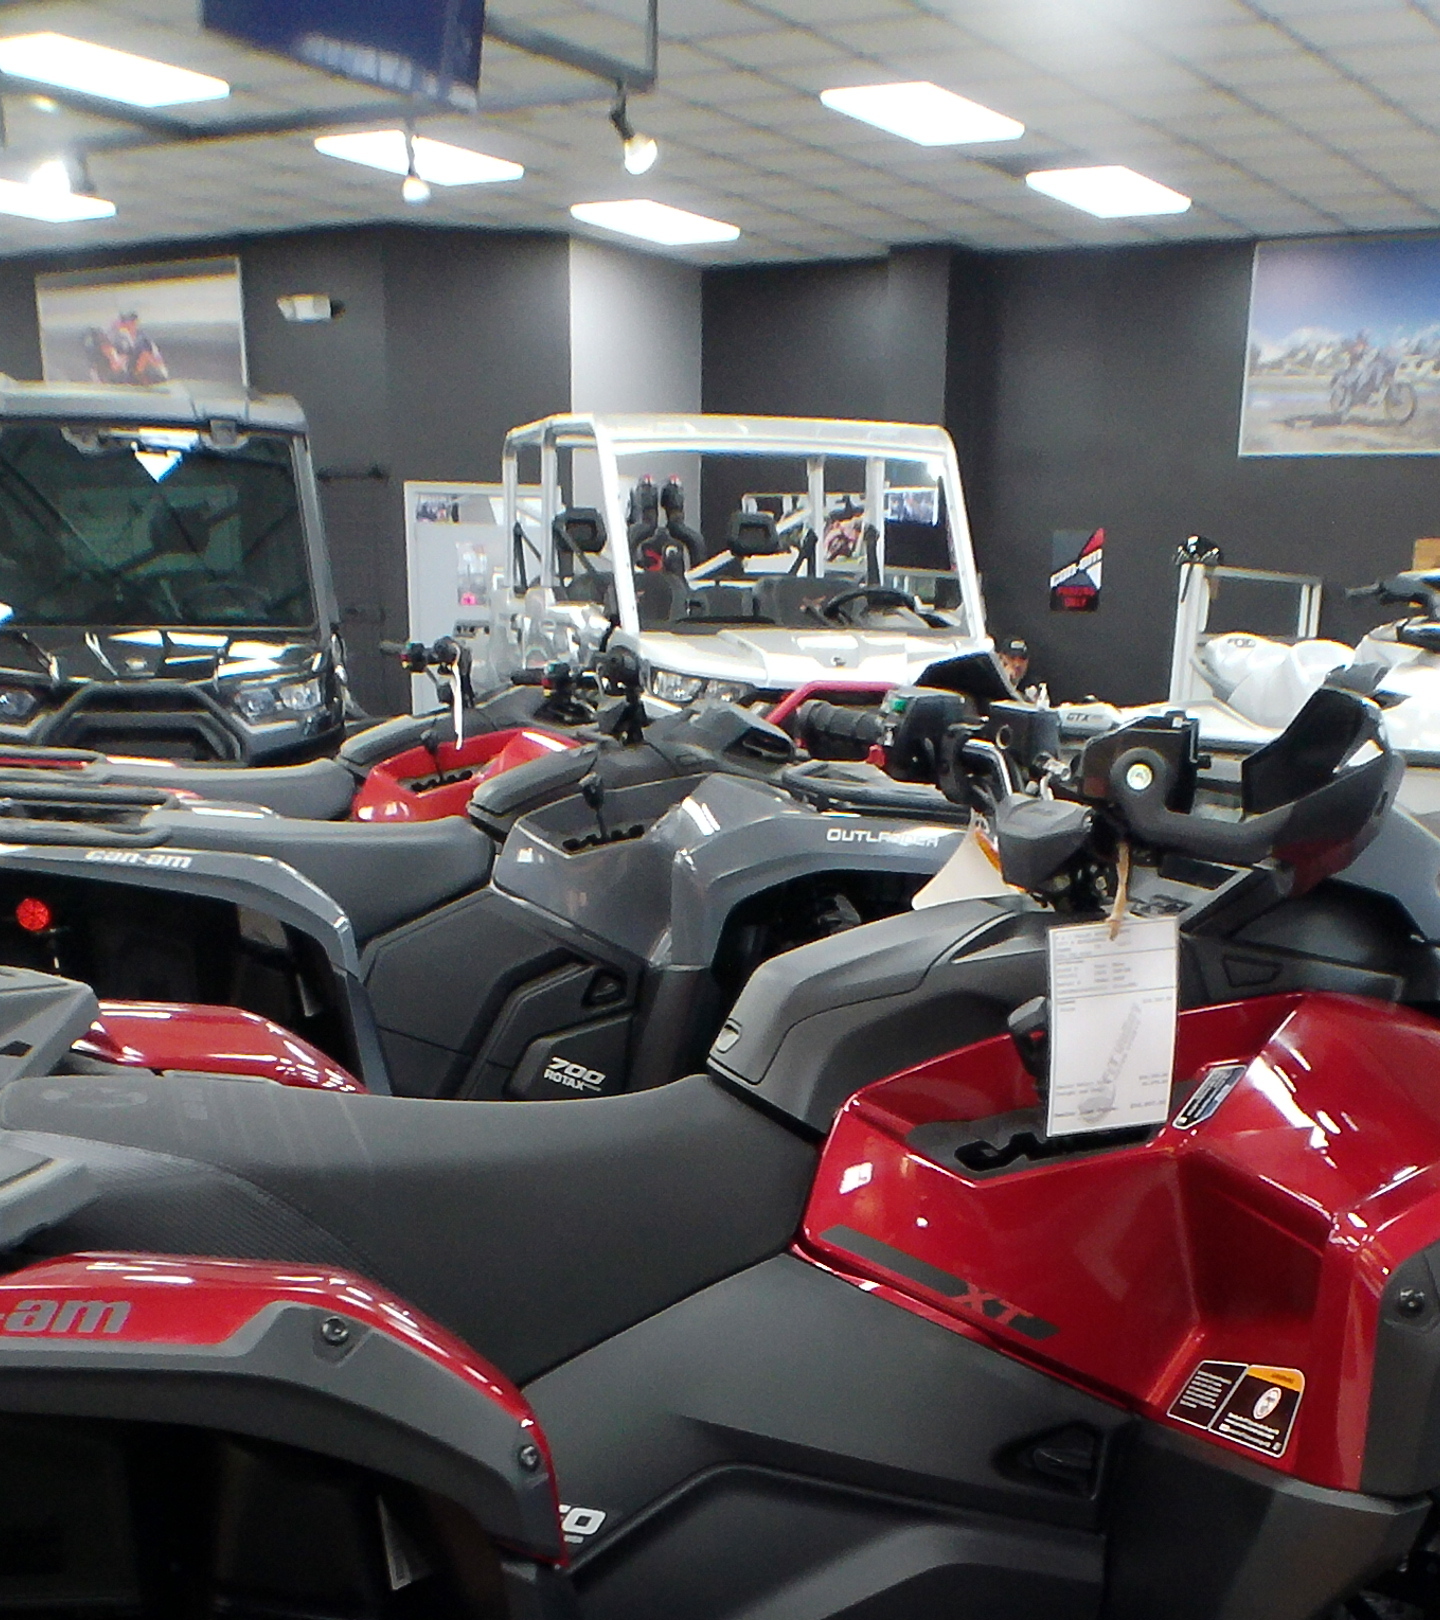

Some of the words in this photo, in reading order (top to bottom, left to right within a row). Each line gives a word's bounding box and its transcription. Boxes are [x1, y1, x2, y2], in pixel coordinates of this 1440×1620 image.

[826, 828, 941, 848] OUTLANDER
[543, 1068, 584, 1091] ROTAX
[548, 1056, 606, 1085] 700
[951, 1280, 1035, 1326] XT
